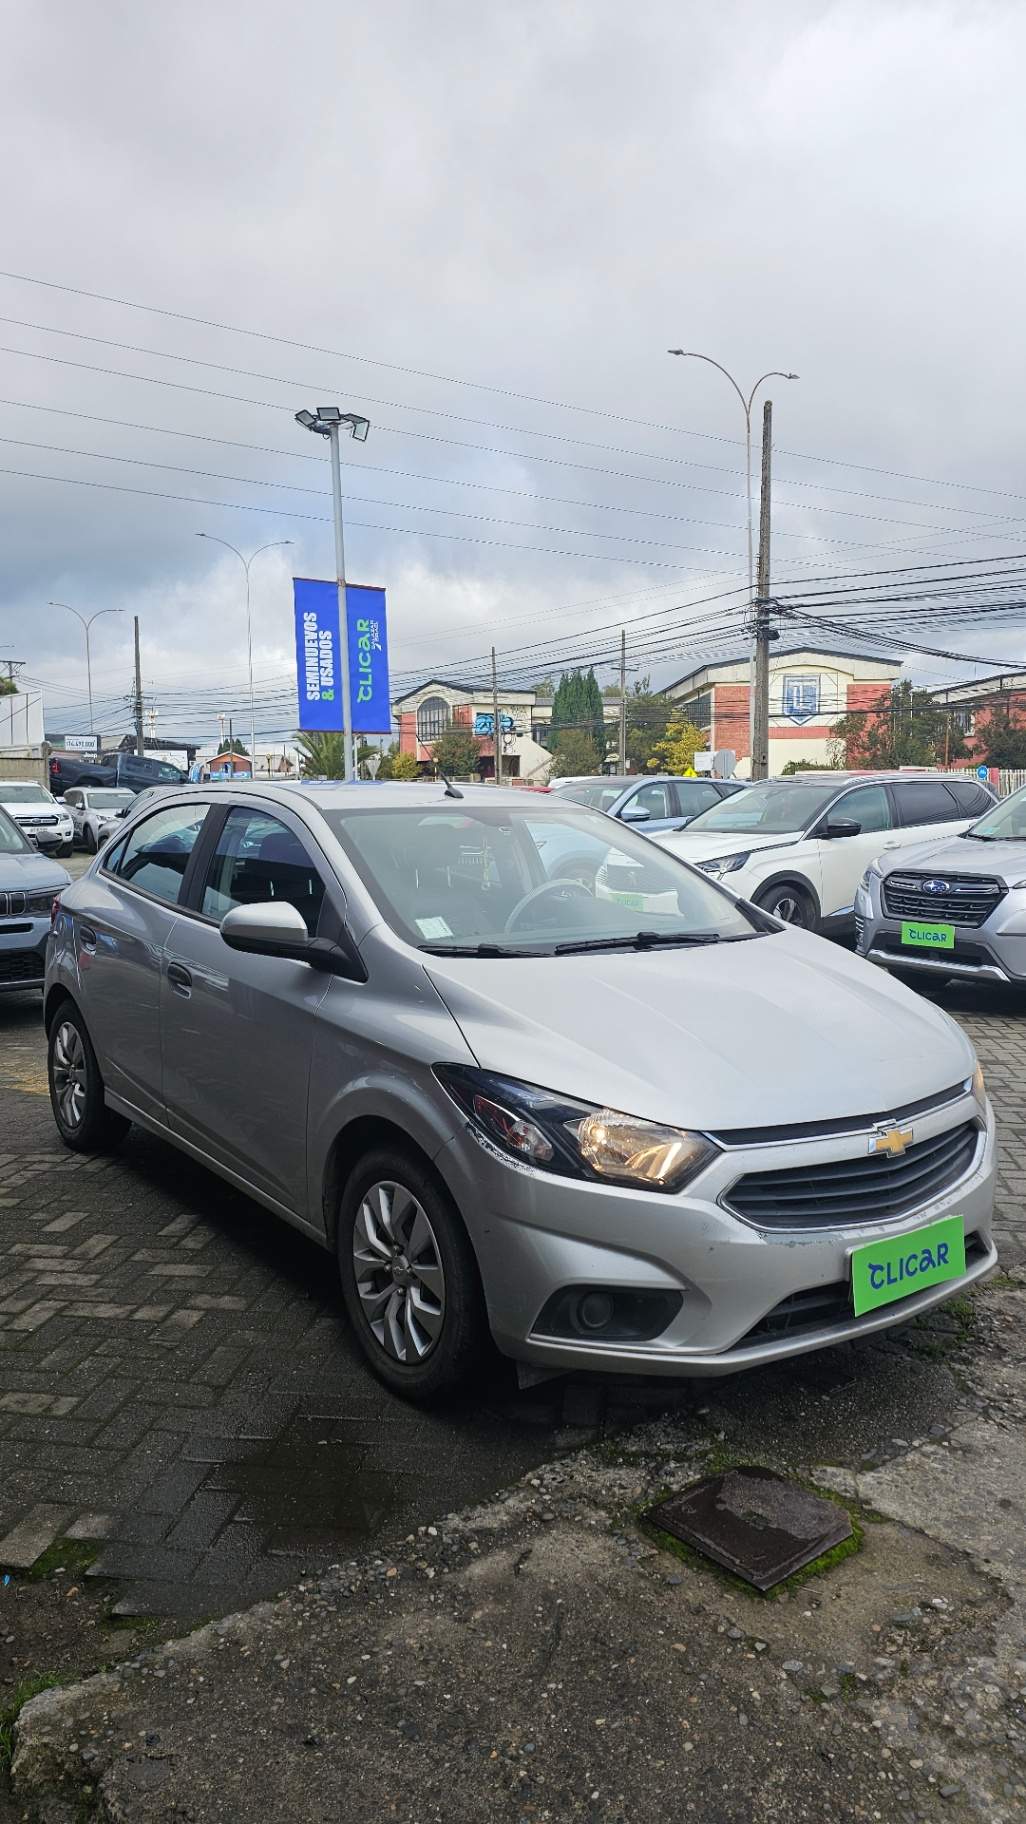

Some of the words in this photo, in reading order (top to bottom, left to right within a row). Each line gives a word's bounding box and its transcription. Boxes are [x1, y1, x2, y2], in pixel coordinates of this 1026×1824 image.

[303, 612, 320, 701] SEMINUEVOS
[319, 630, 334, 687] USADOS
[321, 688, 335, 701] &
